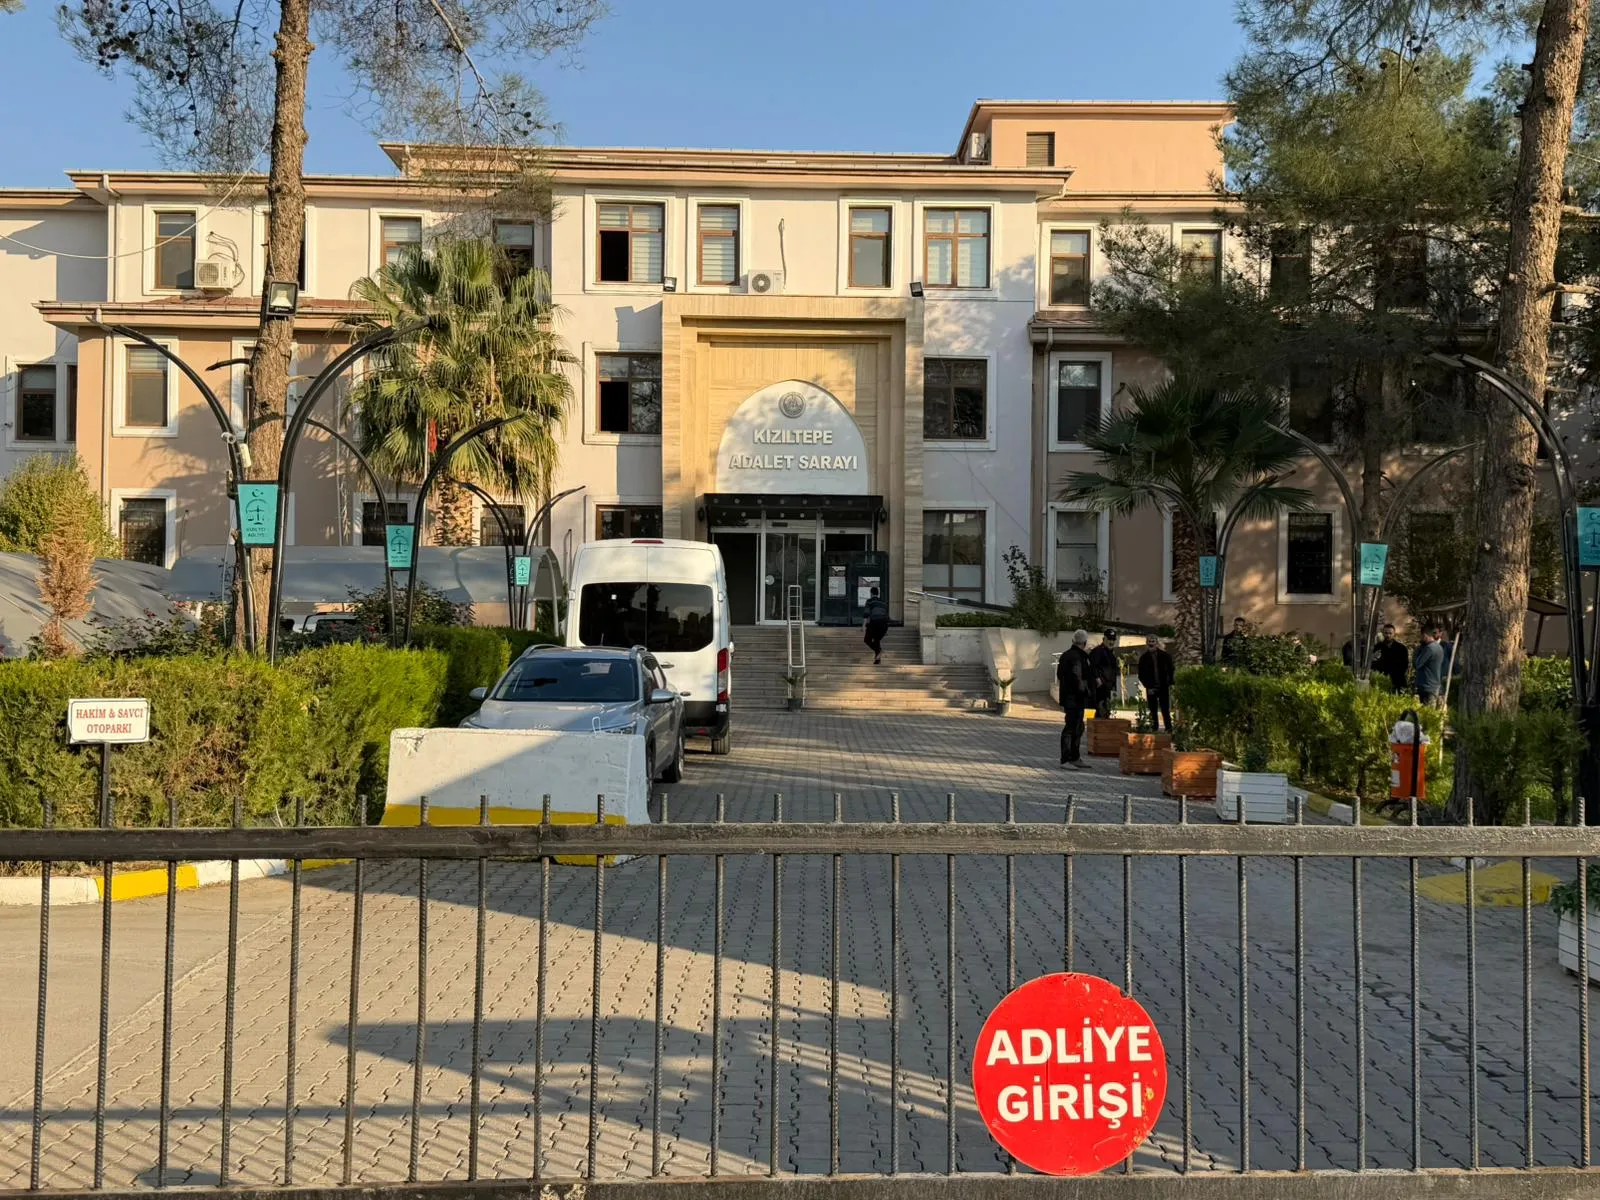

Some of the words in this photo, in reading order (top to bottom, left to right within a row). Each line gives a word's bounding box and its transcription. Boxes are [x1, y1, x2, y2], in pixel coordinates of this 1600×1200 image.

[753, 430, 833, 445] KIZILTEPE
[730, 455, 795, 469] ADALET
[798, 455, 858, 470] SARAYI
[76, 707, 106, 719] HAKİM
[109, 708, 116, 718] &
[118, 708, 143, 718] SAVCI
[87, 724, 132, 733] OTOPARKI
[986, 1017, 1152, 1066] ADLİYE
[997, 1072, 1143, 1129] GİRİŞİ
